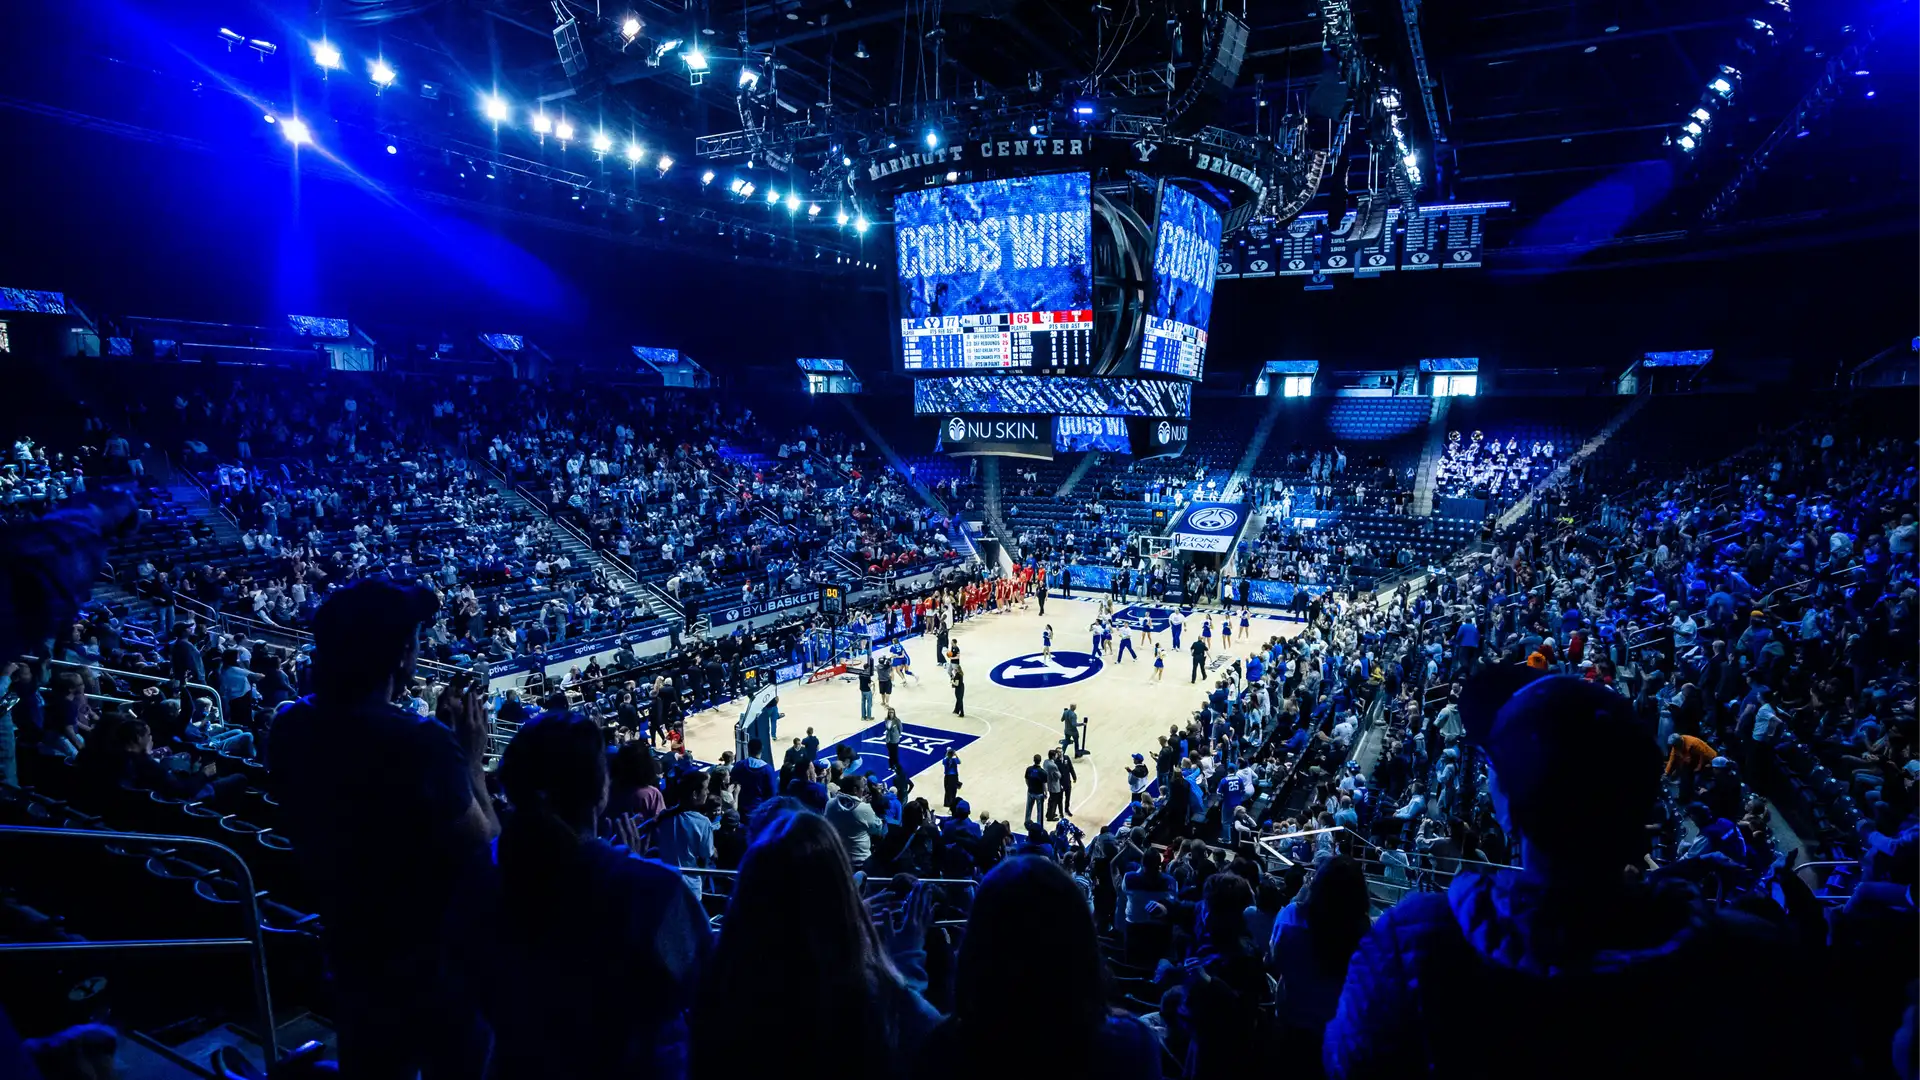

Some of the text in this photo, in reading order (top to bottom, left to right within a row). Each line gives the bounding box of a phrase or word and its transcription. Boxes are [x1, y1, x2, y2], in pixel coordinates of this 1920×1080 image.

[868, 139, 1083, 181] MARRIOTT CENTER
[900, 209, 1086, 279] COUGS WIN
[946, 317, 956, 327] 77
[979, 315, 992, 325] 0.0
[1017, 313, 1030, 324] 65
[968, 421, 992, 438] NU
[1182, 536, 1220, 544] ZIONS
[489, 665, 508, 676] ptive
[1228, 780, 1240, 792] 25
